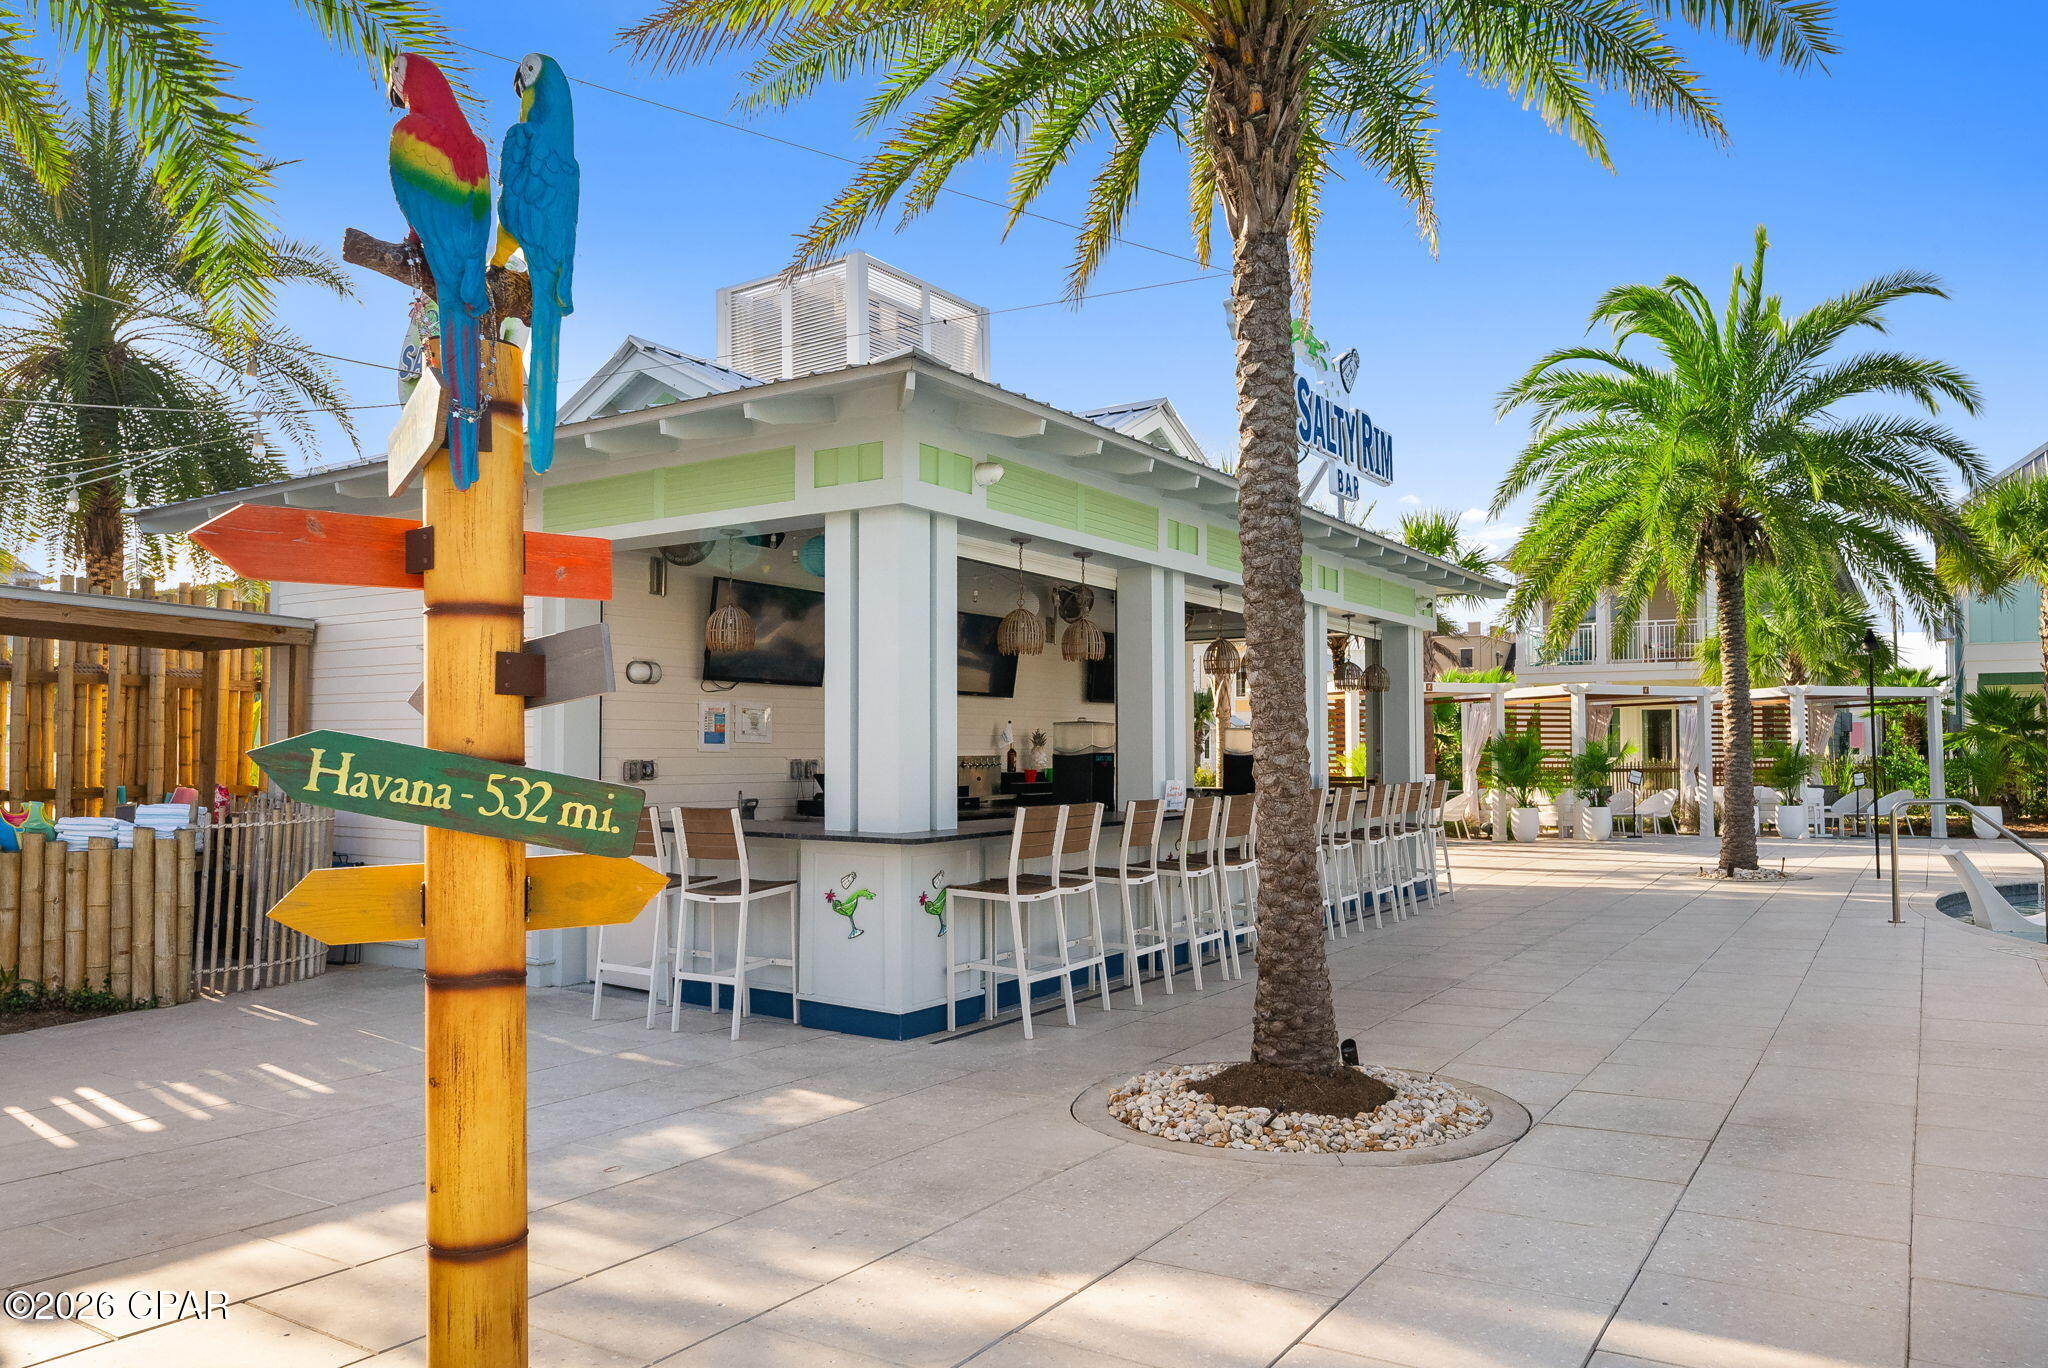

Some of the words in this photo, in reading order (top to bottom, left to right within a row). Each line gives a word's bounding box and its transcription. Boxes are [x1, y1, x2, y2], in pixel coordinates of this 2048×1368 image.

[1297, 377, 1355, 462] SALTY
[1362, 413, 1393, 482] RIM
[1337, 470, 1360, 500] BAR
[303, 748, 451, 810] Havana
[479, 773, 553, 823] 532
[557, 793, 621, 834] mi.
